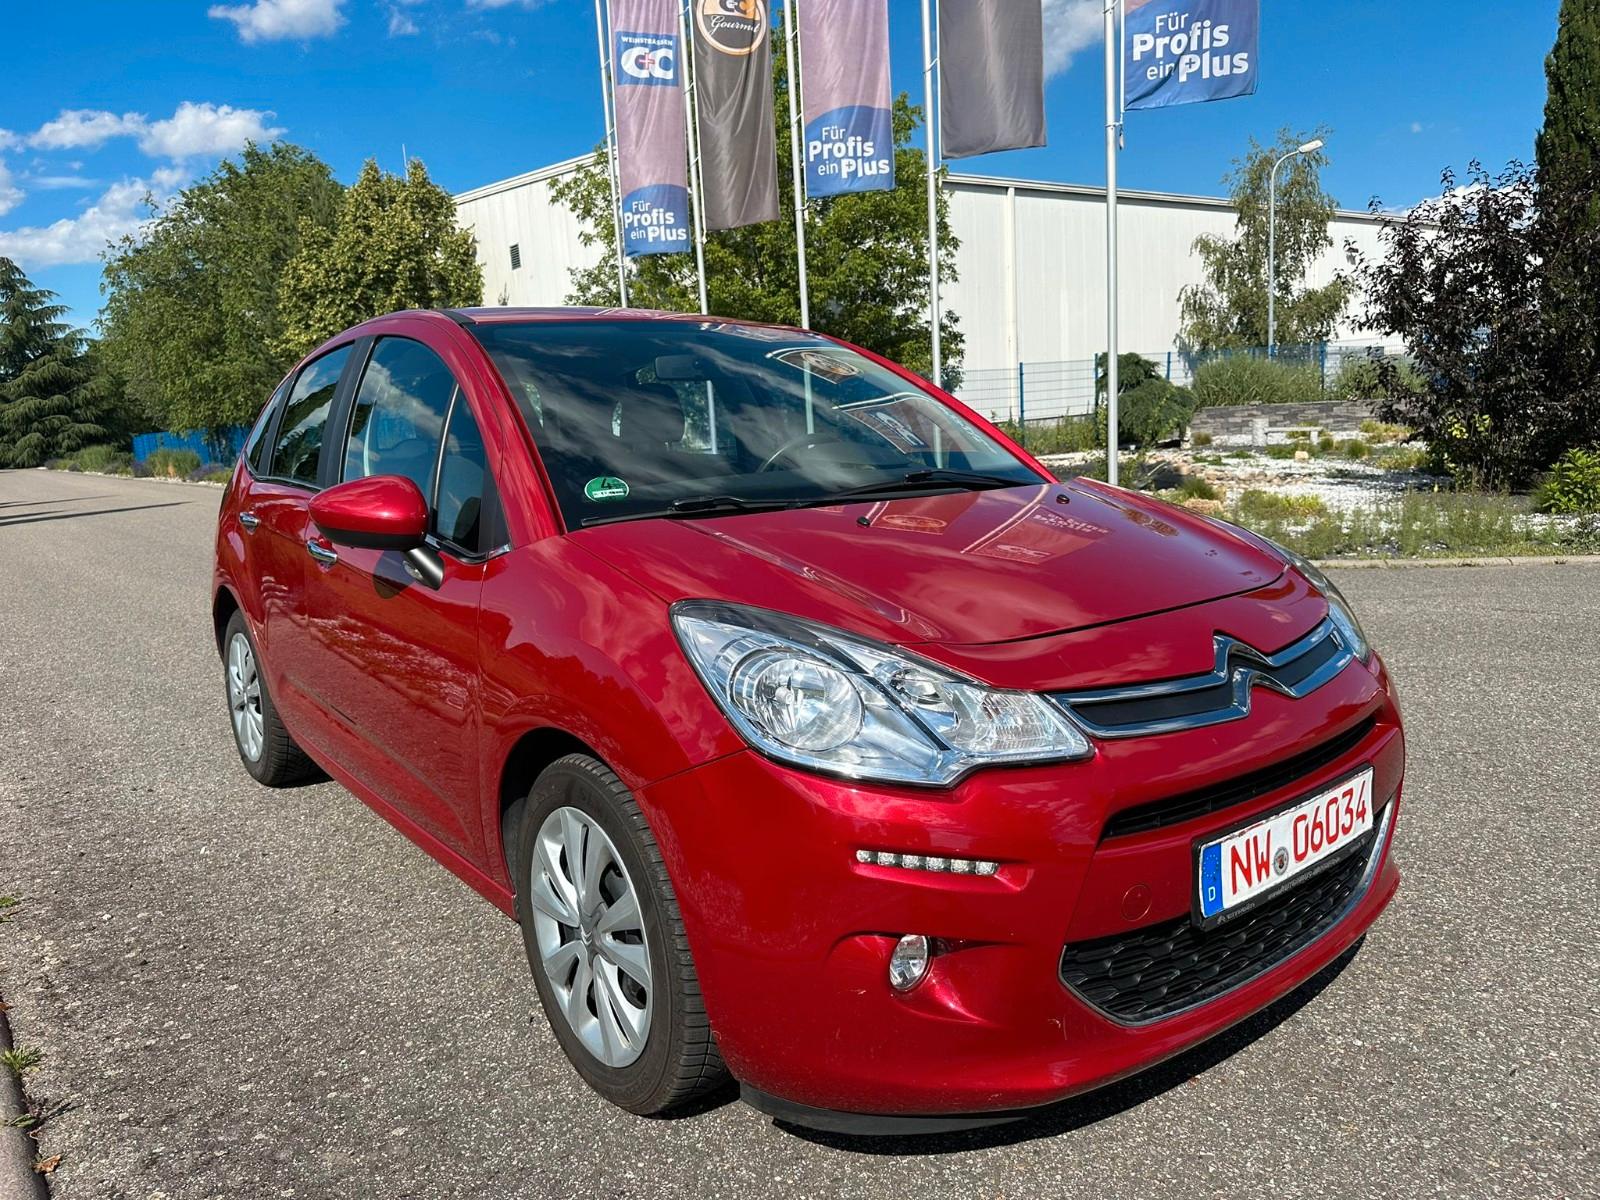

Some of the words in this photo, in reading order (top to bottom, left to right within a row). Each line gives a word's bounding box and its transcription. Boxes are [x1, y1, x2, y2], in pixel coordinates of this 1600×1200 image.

[1155, 12, 1189, 34] Für
[1132, 20, 1230, 61] Profis
[1146, 61, 1175, 80] ein
[1178, 50, 1249, 83] Plus
[822, 125, 846, 141] Für
[808, 136, 875, 162] Profis
[817, 161, 839, 176] ein
[841, 158, 890, 179] Plus
[632, 200, 652, 213] Für
[624, 208, 675, 229] Profis
[630, 228, 646, 240] ein
[647, 225, 687, 243] Plus
[1208, 886, 1216, 902] D
[1230, 829, 1271, 896] NW
[1292, 780, 1367, 864] 06034
